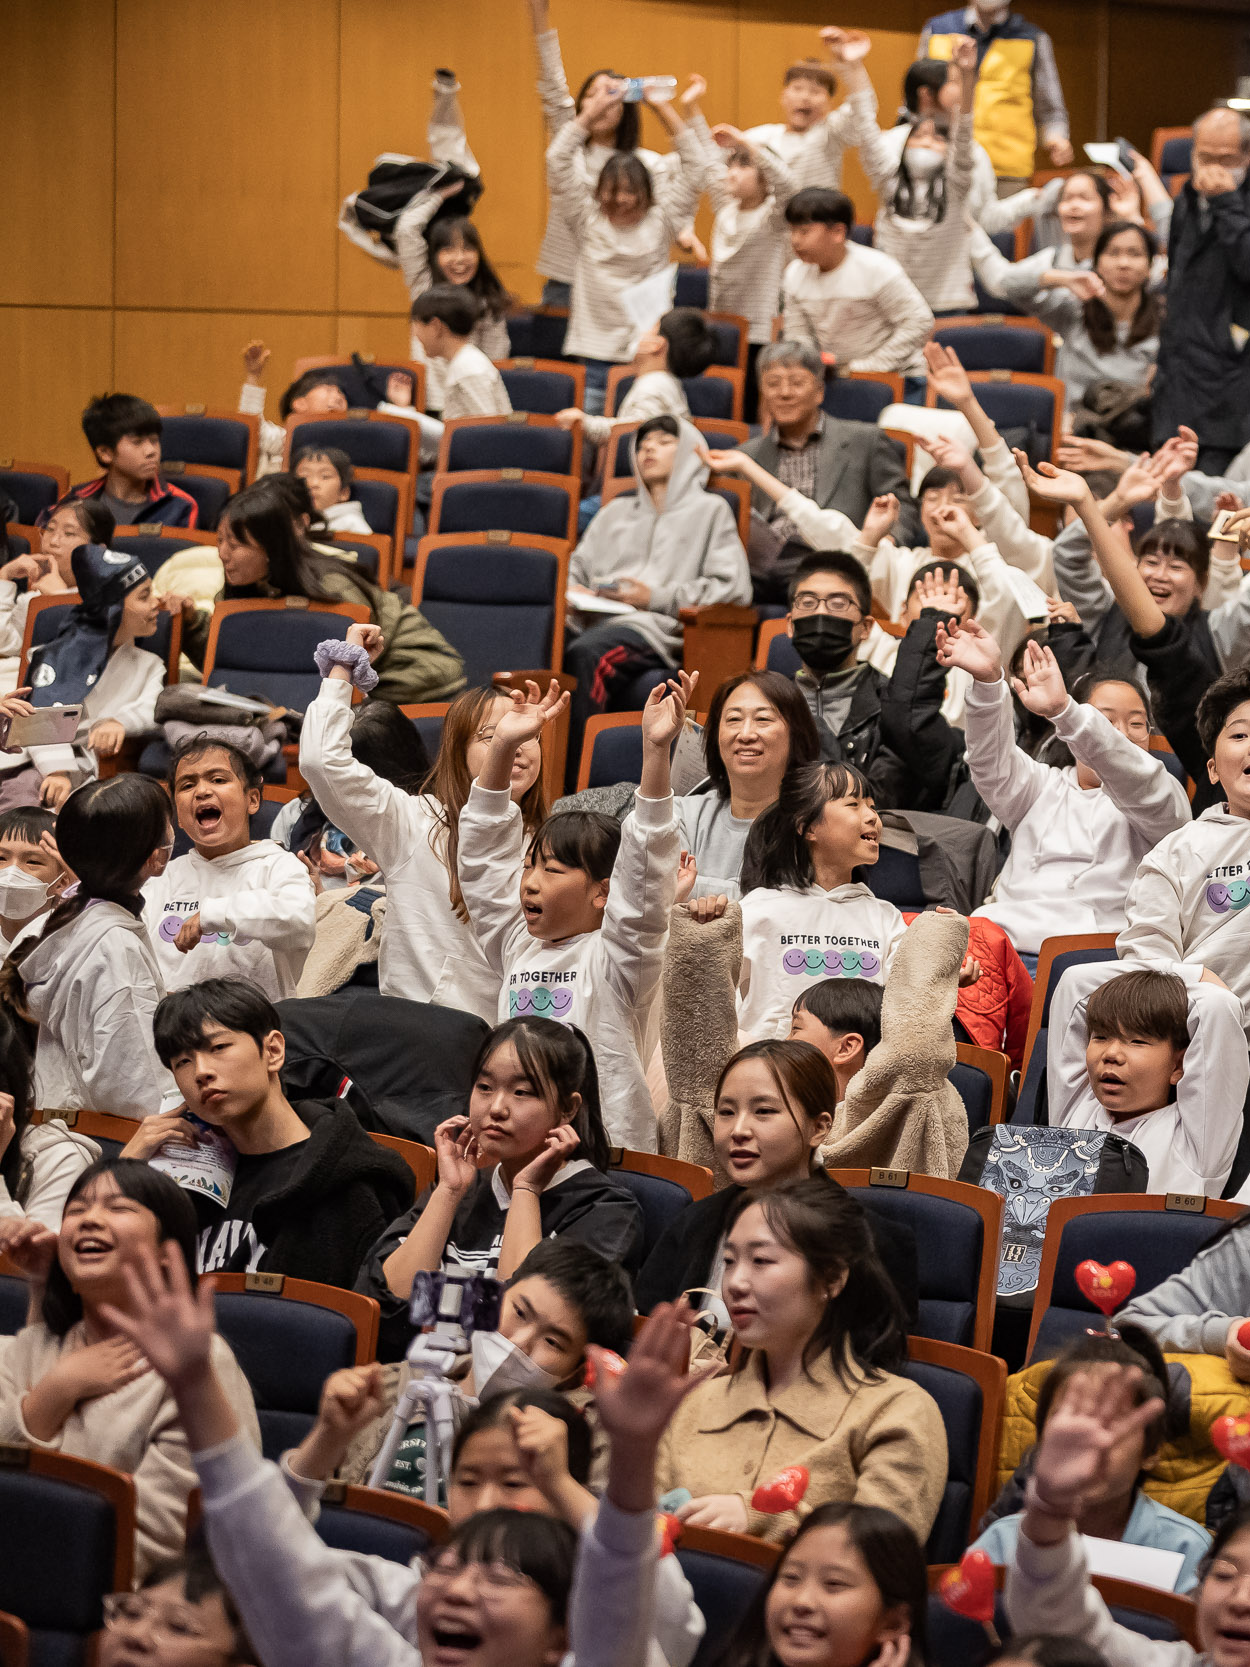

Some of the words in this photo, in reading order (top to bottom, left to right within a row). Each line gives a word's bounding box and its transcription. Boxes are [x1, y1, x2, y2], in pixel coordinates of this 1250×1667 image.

[163, 901, 200, 912] BETTER
[780, 935, 821, 945] BETTER
[824, 935, 880, 949] TOGETHER
[520, 971, 577, 984] TOGETHER
[879, 1171, 885, 1180] B
[888, 1172, 898, 1181] 61
[1175, 1196, 1181, 1205] B
[1184, 1197, 1196, 1206] 60
[395, 1459, 412, 1471] EST.
